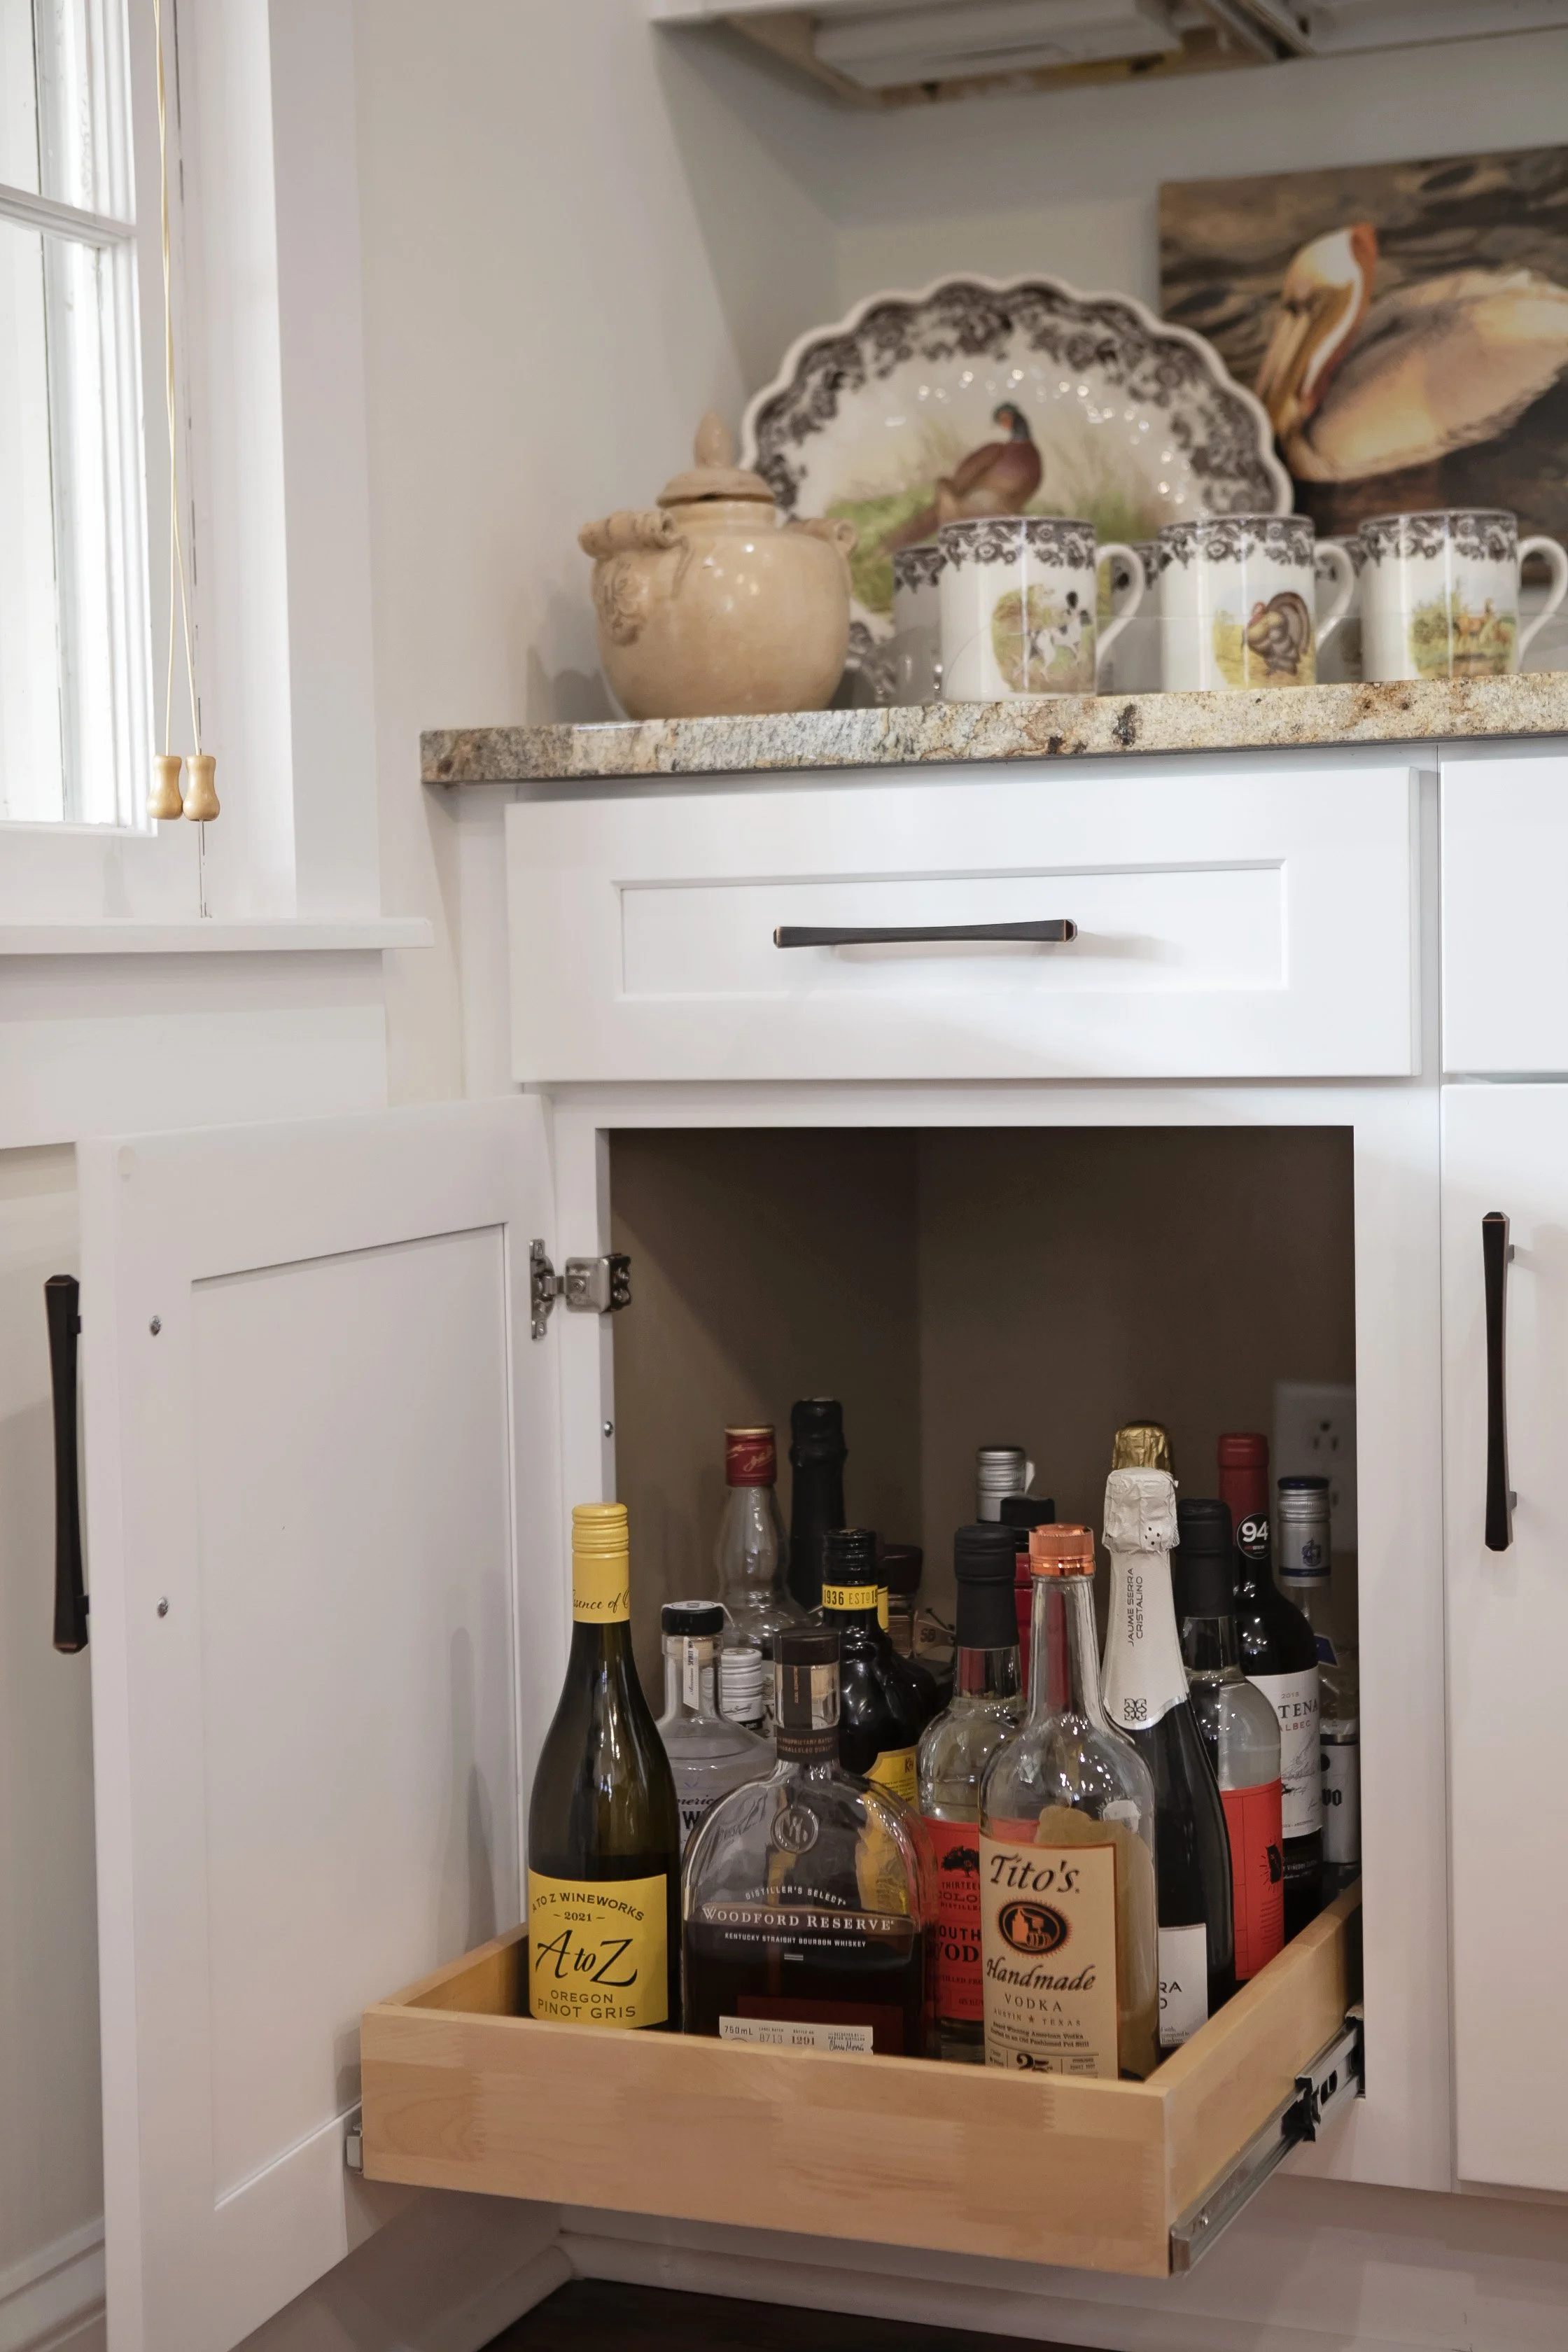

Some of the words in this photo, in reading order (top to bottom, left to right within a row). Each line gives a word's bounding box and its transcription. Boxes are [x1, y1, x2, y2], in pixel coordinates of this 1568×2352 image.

[1242, 1520, 1268, 1543] 94
[608, 1592, 622, 1614] of
[824, 1590, 844, 1606] 1936
[990, 1853, 1080, 1893] Tito's
[744, 1884, 803, 1900] DISTILLER'S
[942, 1881, 980, 1891] THIRTEE
[536, 1896, 547, 1908] TO
[550, 1893, 556, 1903] Z
[559, 1891, 645, 1921] WINEWORKS
[941, 1901, 981, 1911] DISTILLE
[564, 1911, 592, 1922] 2021
[702, 1907, 799, 1927] WOODFORD
[806, 1914, 891, 1931] RESERVE
[724, 1932, 760, 1942] KENTUCKY
[762, 1934, 797, 1945] STRAIGHT
[799, 1936, 832, 1947] BOURBON
[834, 1938, 867, 1948] WHISKEY
[938, 1924, 981, 1942] OUTH
[986, 1956, 1096, 1991] Handmade
[550, 1989, 613, 2004] OREGON
[1004, 1993, 1063, 2012] VODKA
[538, 1998, 582, 2018] PINOT
[590, 2005, 636, 2019] GRIS
[994, 2008, 1022, 2022] AUSTIN
[1042, 2017, 1082, 2027] TEXAS
[724, 2026, 753, 2036] 750mL
[1031, 2030, 1062, 2040] American
